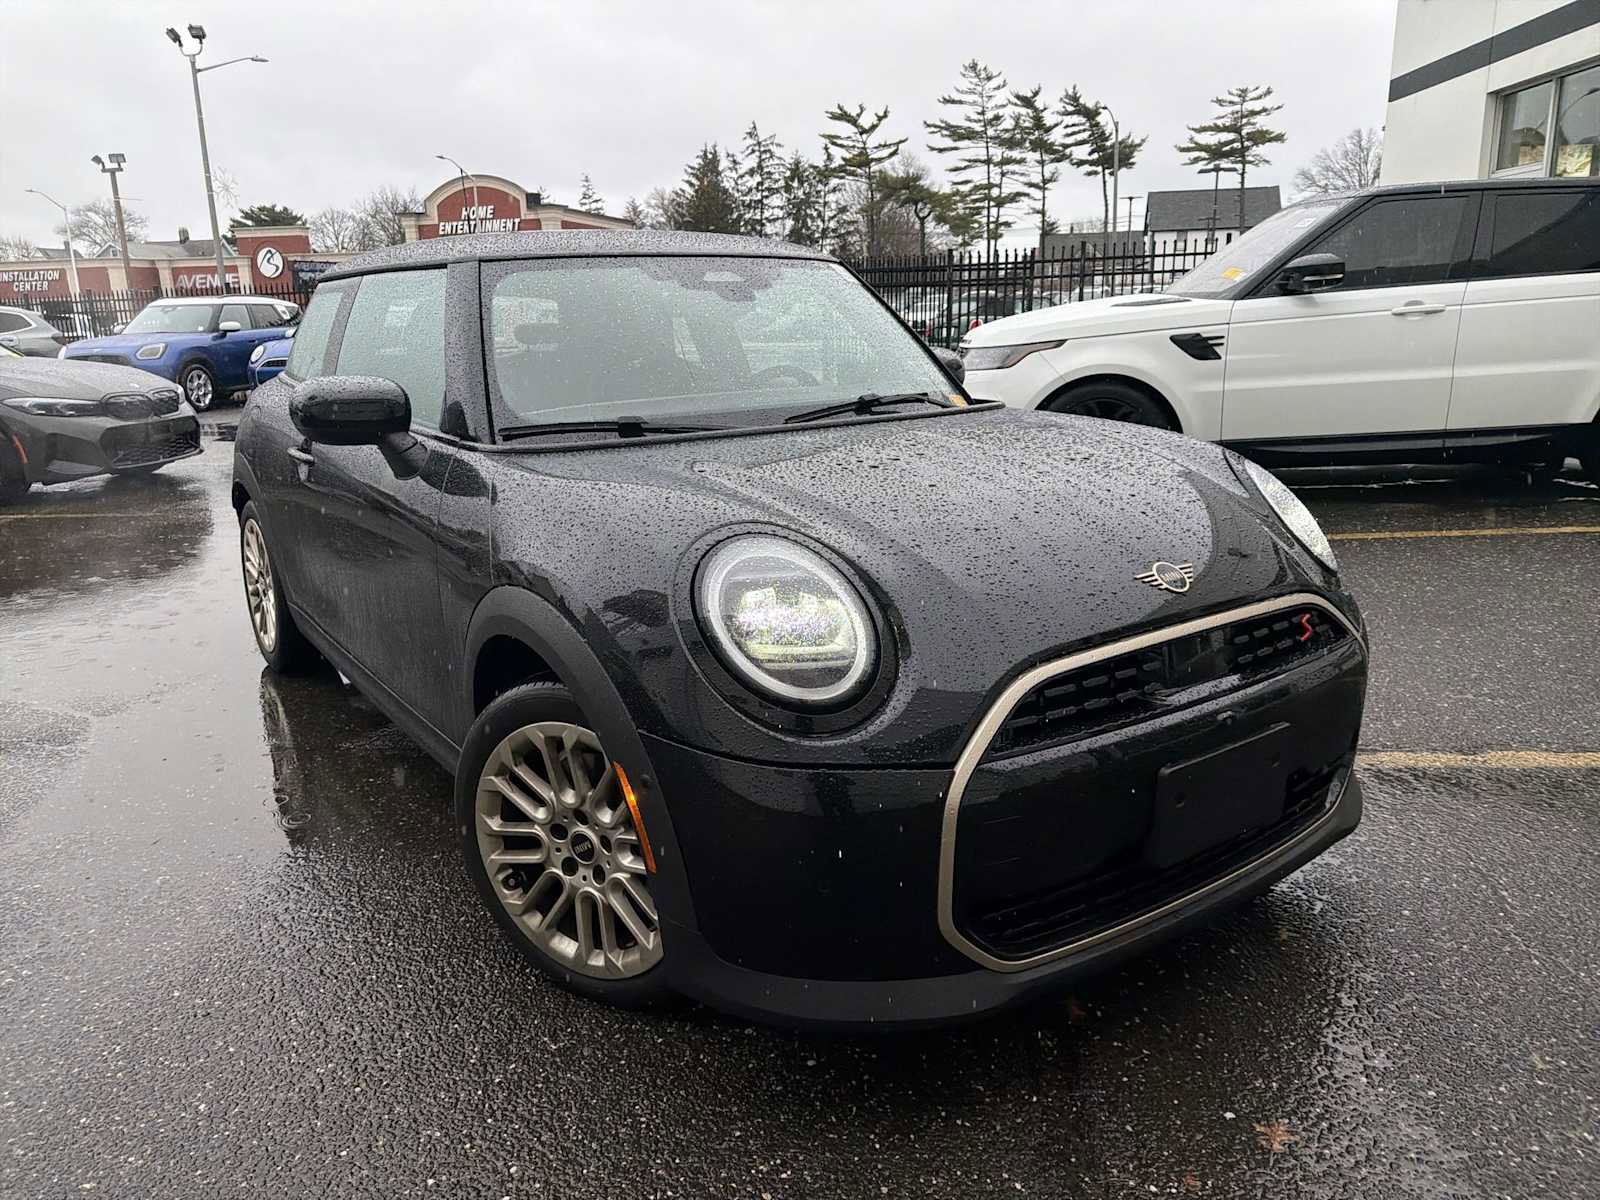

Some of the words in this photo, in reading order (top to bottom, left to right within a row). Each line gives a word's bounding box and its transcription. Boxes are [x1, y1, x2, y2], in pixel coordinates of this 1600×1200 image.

[461, 205, 494, 220] HOME
[0, 270, 60, 282] INSTALLATION
[13, 281, 49, 292] CENTER
[1299, 613, 1313, 641] S
